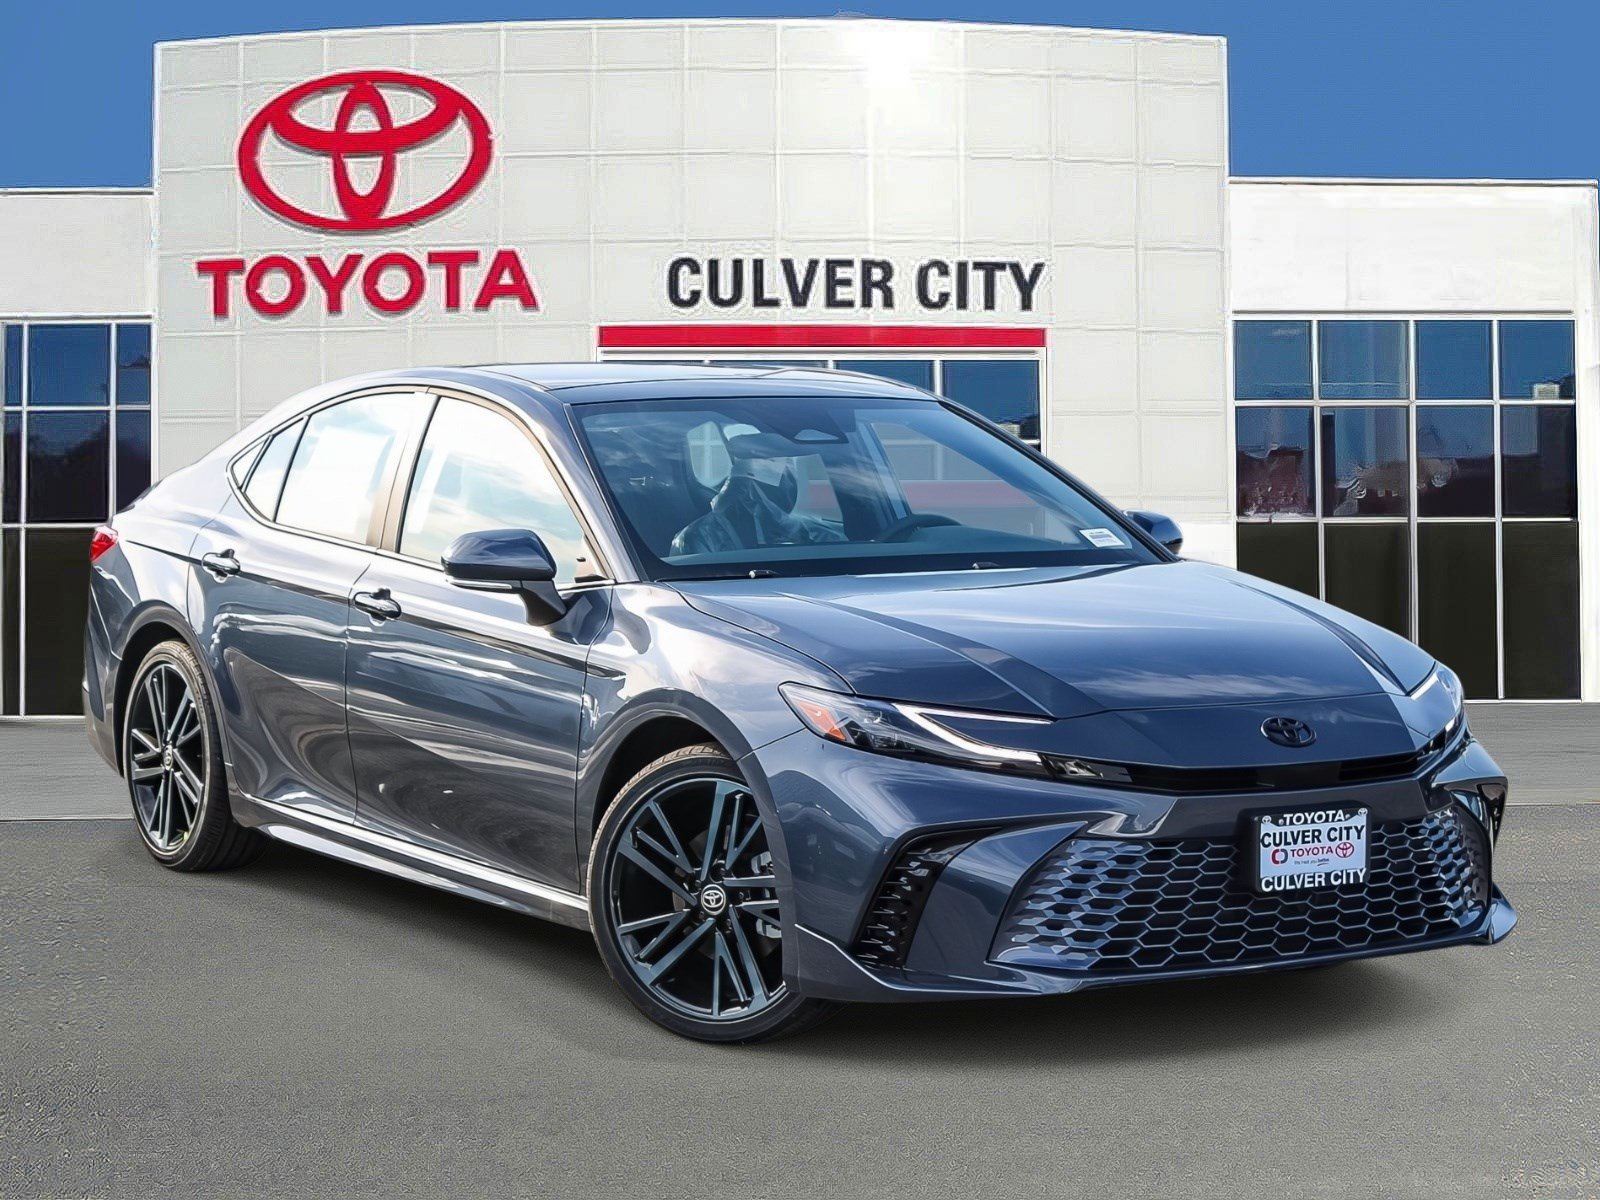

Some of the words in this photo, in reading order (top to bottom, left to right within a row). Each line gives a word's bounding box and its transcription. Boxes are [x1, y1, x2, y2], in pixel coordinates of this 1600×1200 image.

[196, 250, 539, 319] TOYOTA
[667, 257, 894, 309] CULVER
[917, 259, 1045, 311] CITY
[1283, 810, 1345, 825] TOYOTA
[1260, 829, 1322, 848] CULVER
[1327, 825, 1365, 842] CITY
[1290, 846, 1333, 858] TOYOTA
[1261, 873, 1326, 892] CULVER
[1330, 868, 1366, 885] CITY
